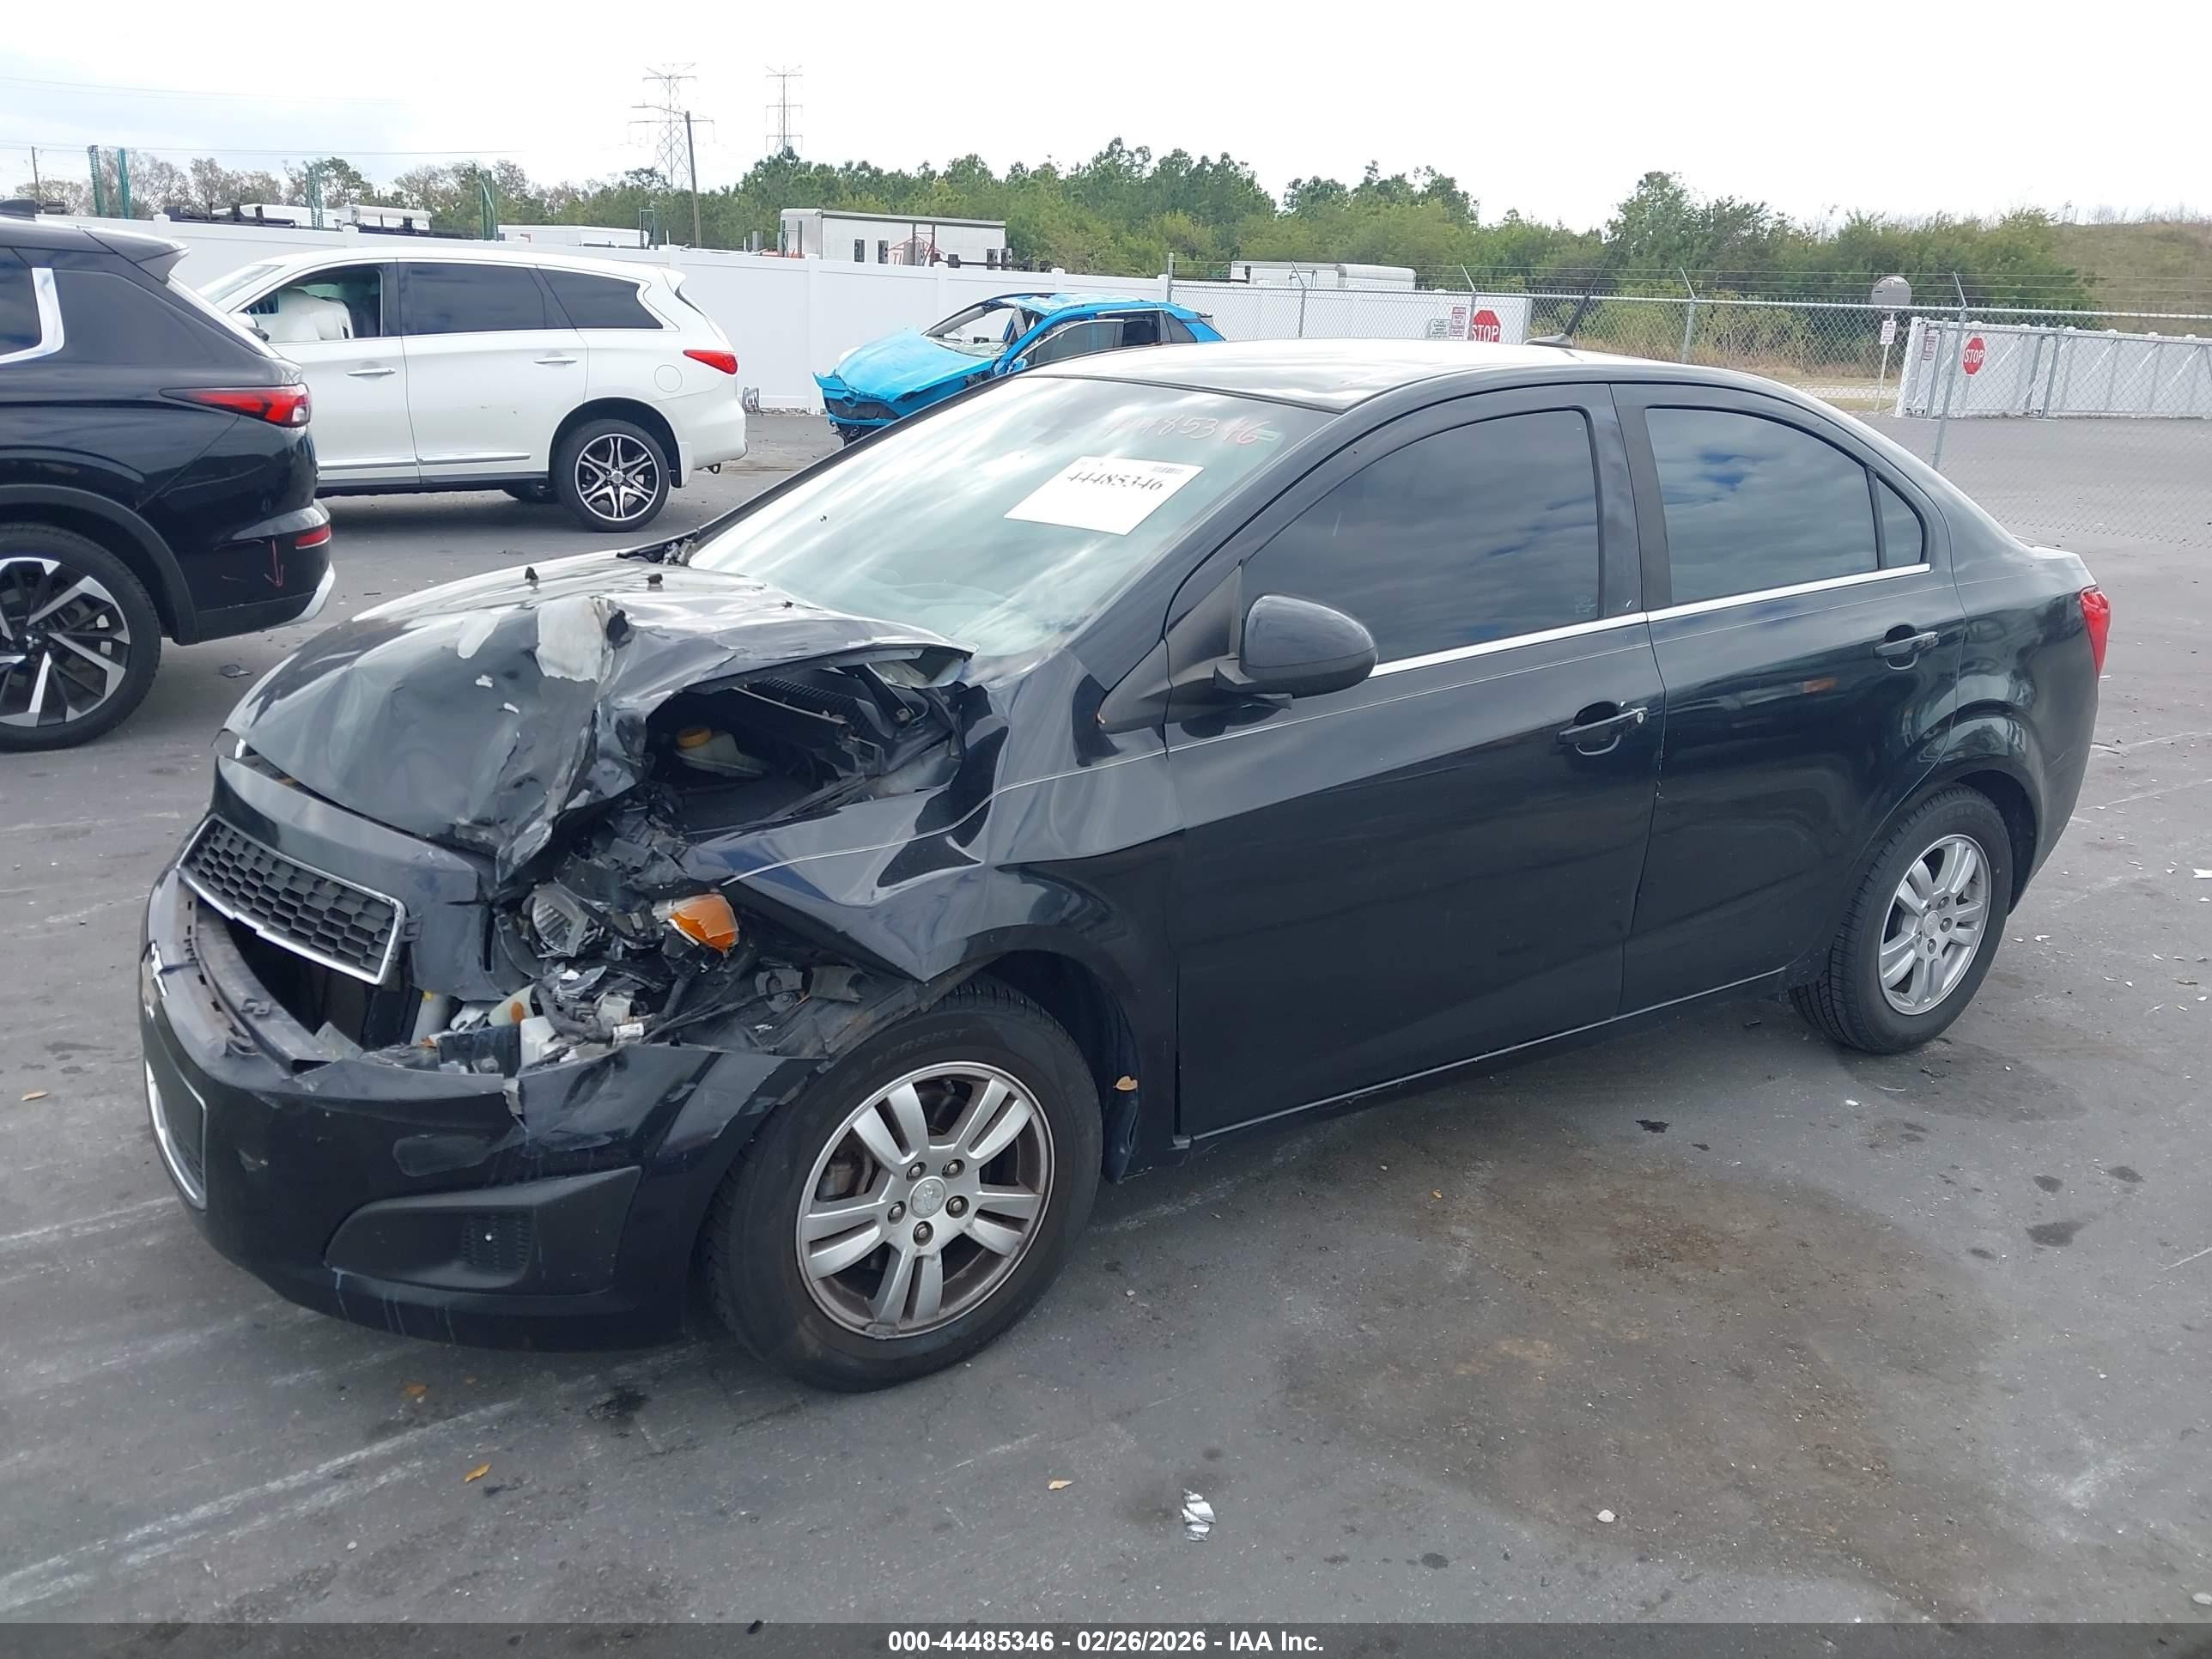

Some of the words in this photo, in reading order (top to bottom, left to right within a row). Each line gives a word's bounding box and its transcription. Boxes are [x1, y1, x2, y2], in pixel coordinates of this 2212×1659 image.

[1472, 324, 1498, 342] STOP
[1964, 349, 1984, 364] STOP
[1067, 471, 1164, 491] 44485346
